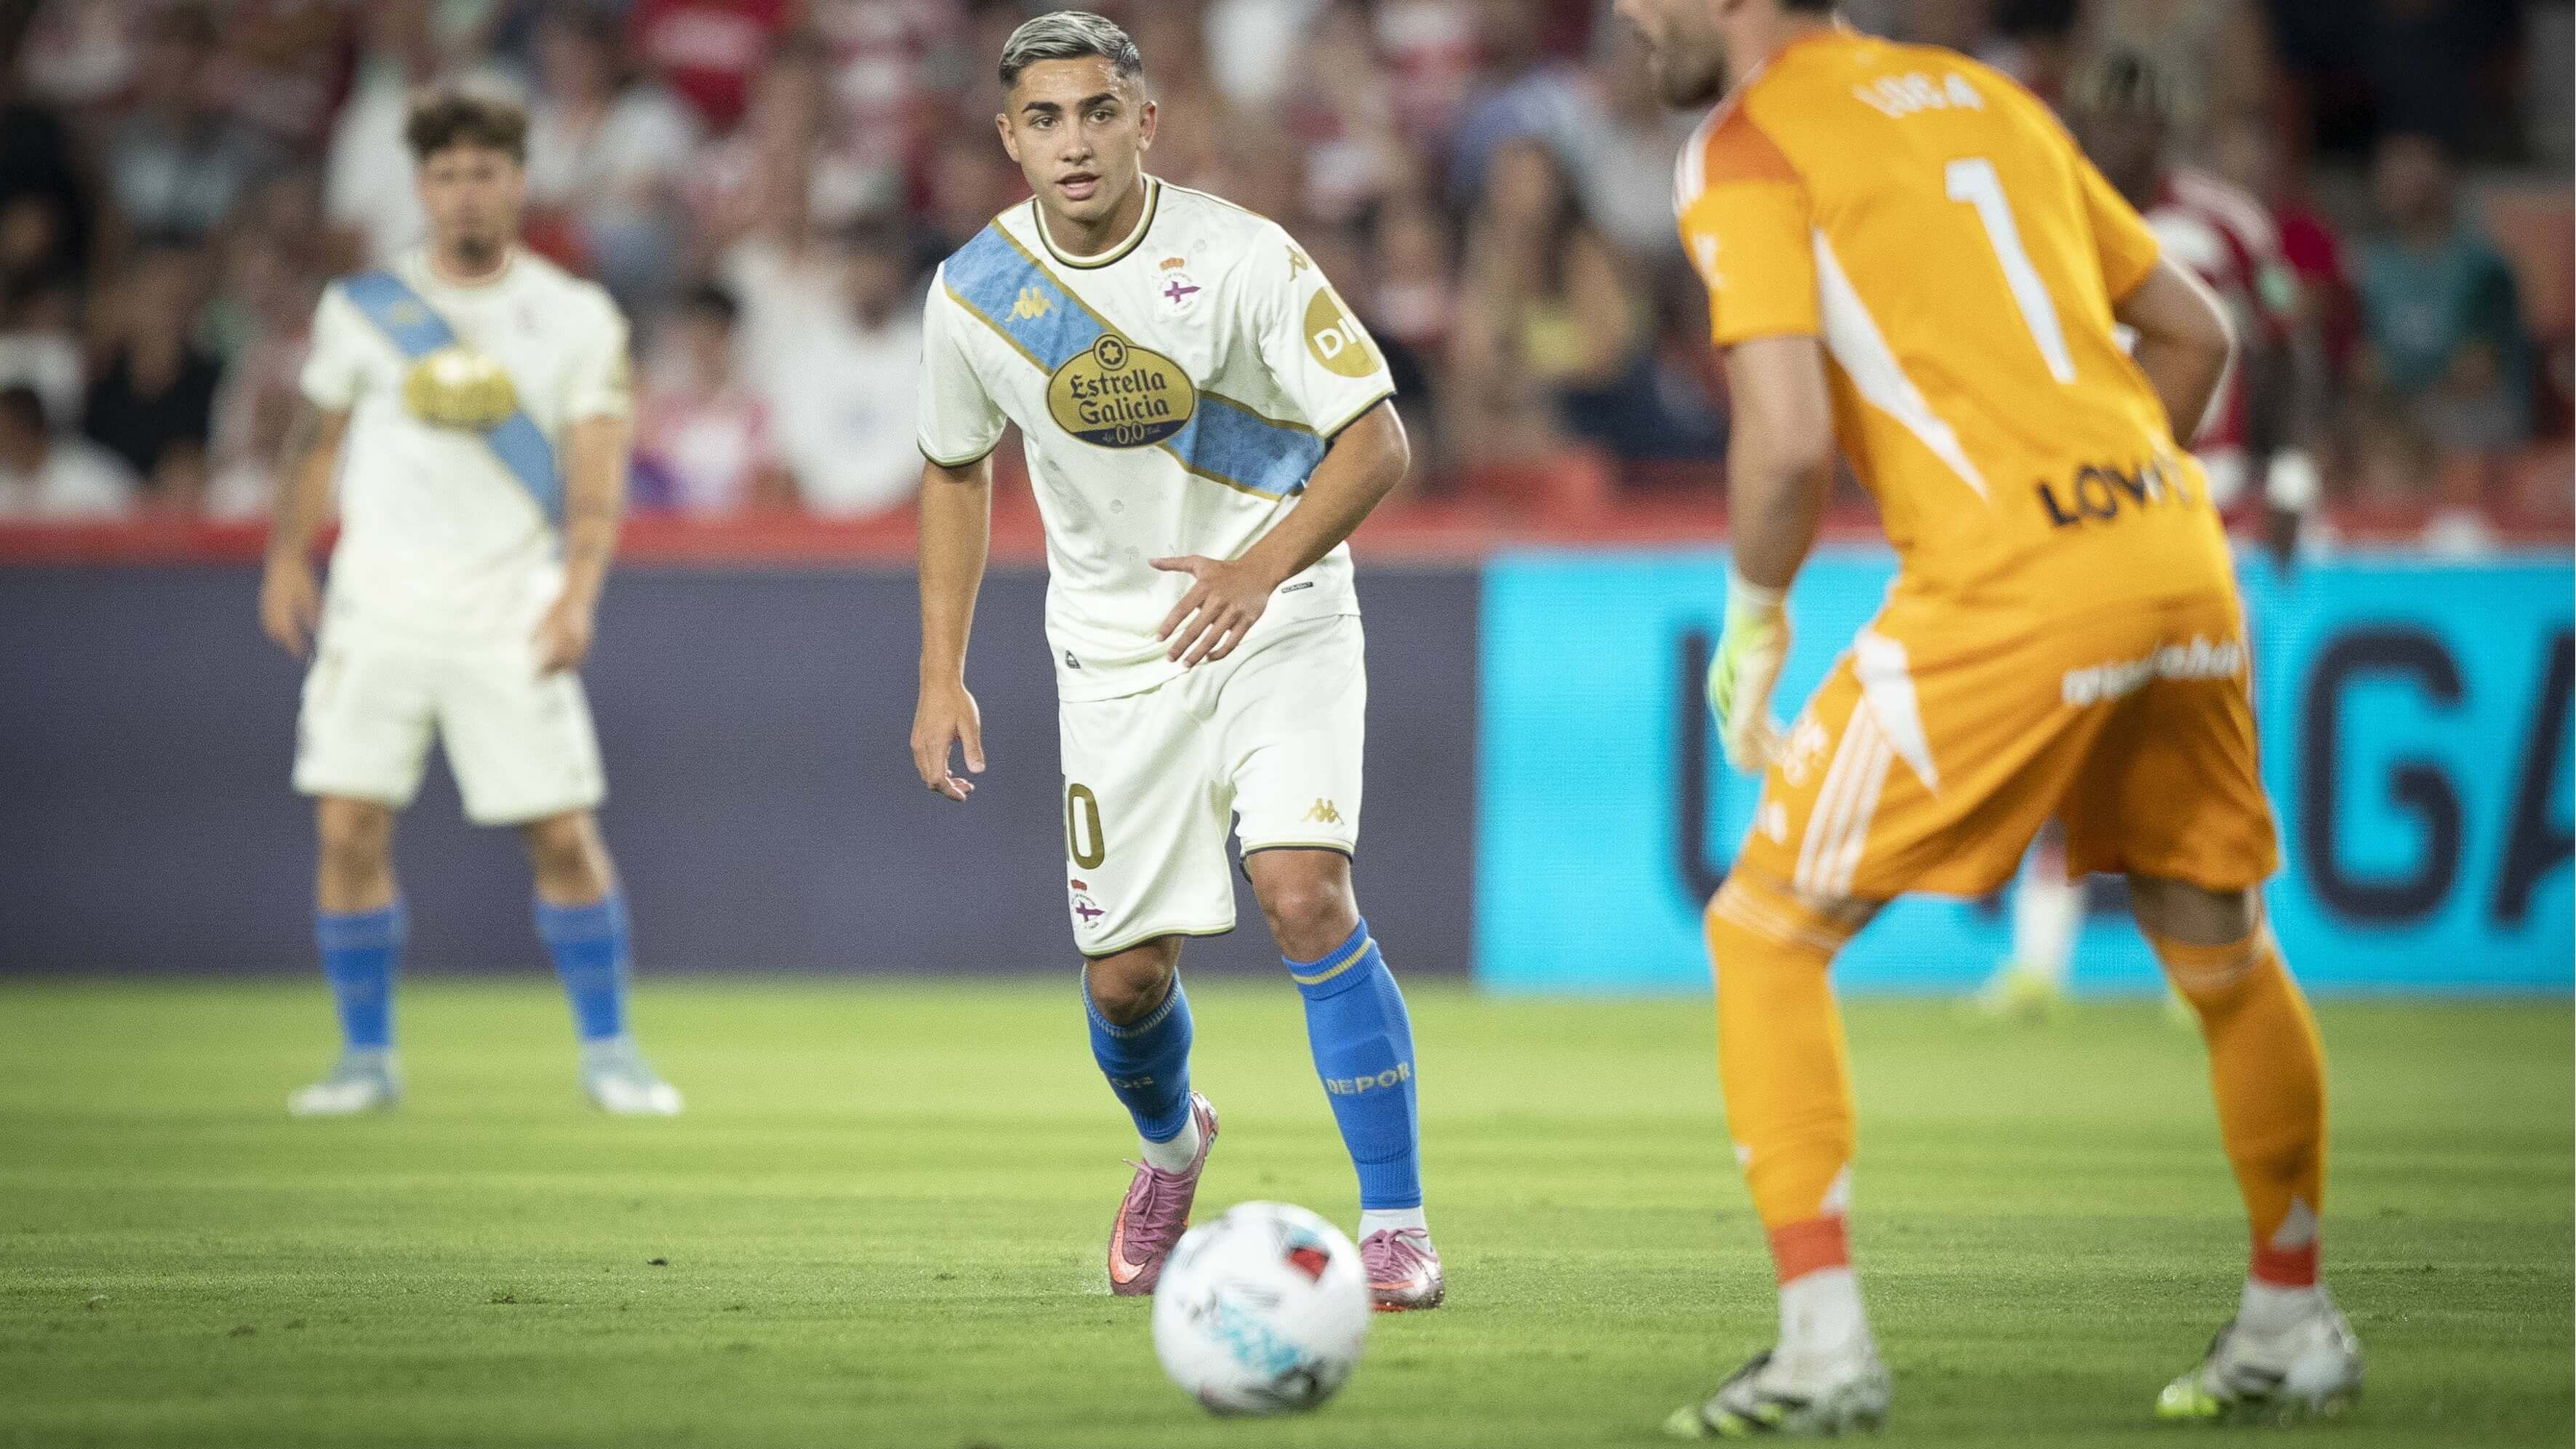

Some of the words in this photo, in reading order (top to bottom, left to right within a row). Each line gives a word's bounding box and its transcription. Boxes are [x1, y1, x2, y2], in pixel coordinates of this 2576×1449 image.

[1944, 159, 2076, 383] 1
[1071, 370, 1167, 399] Estrella
[1079, 395, 1169, 424] Galicia
[1327, 1062, 1409, 1094] DEPOR
